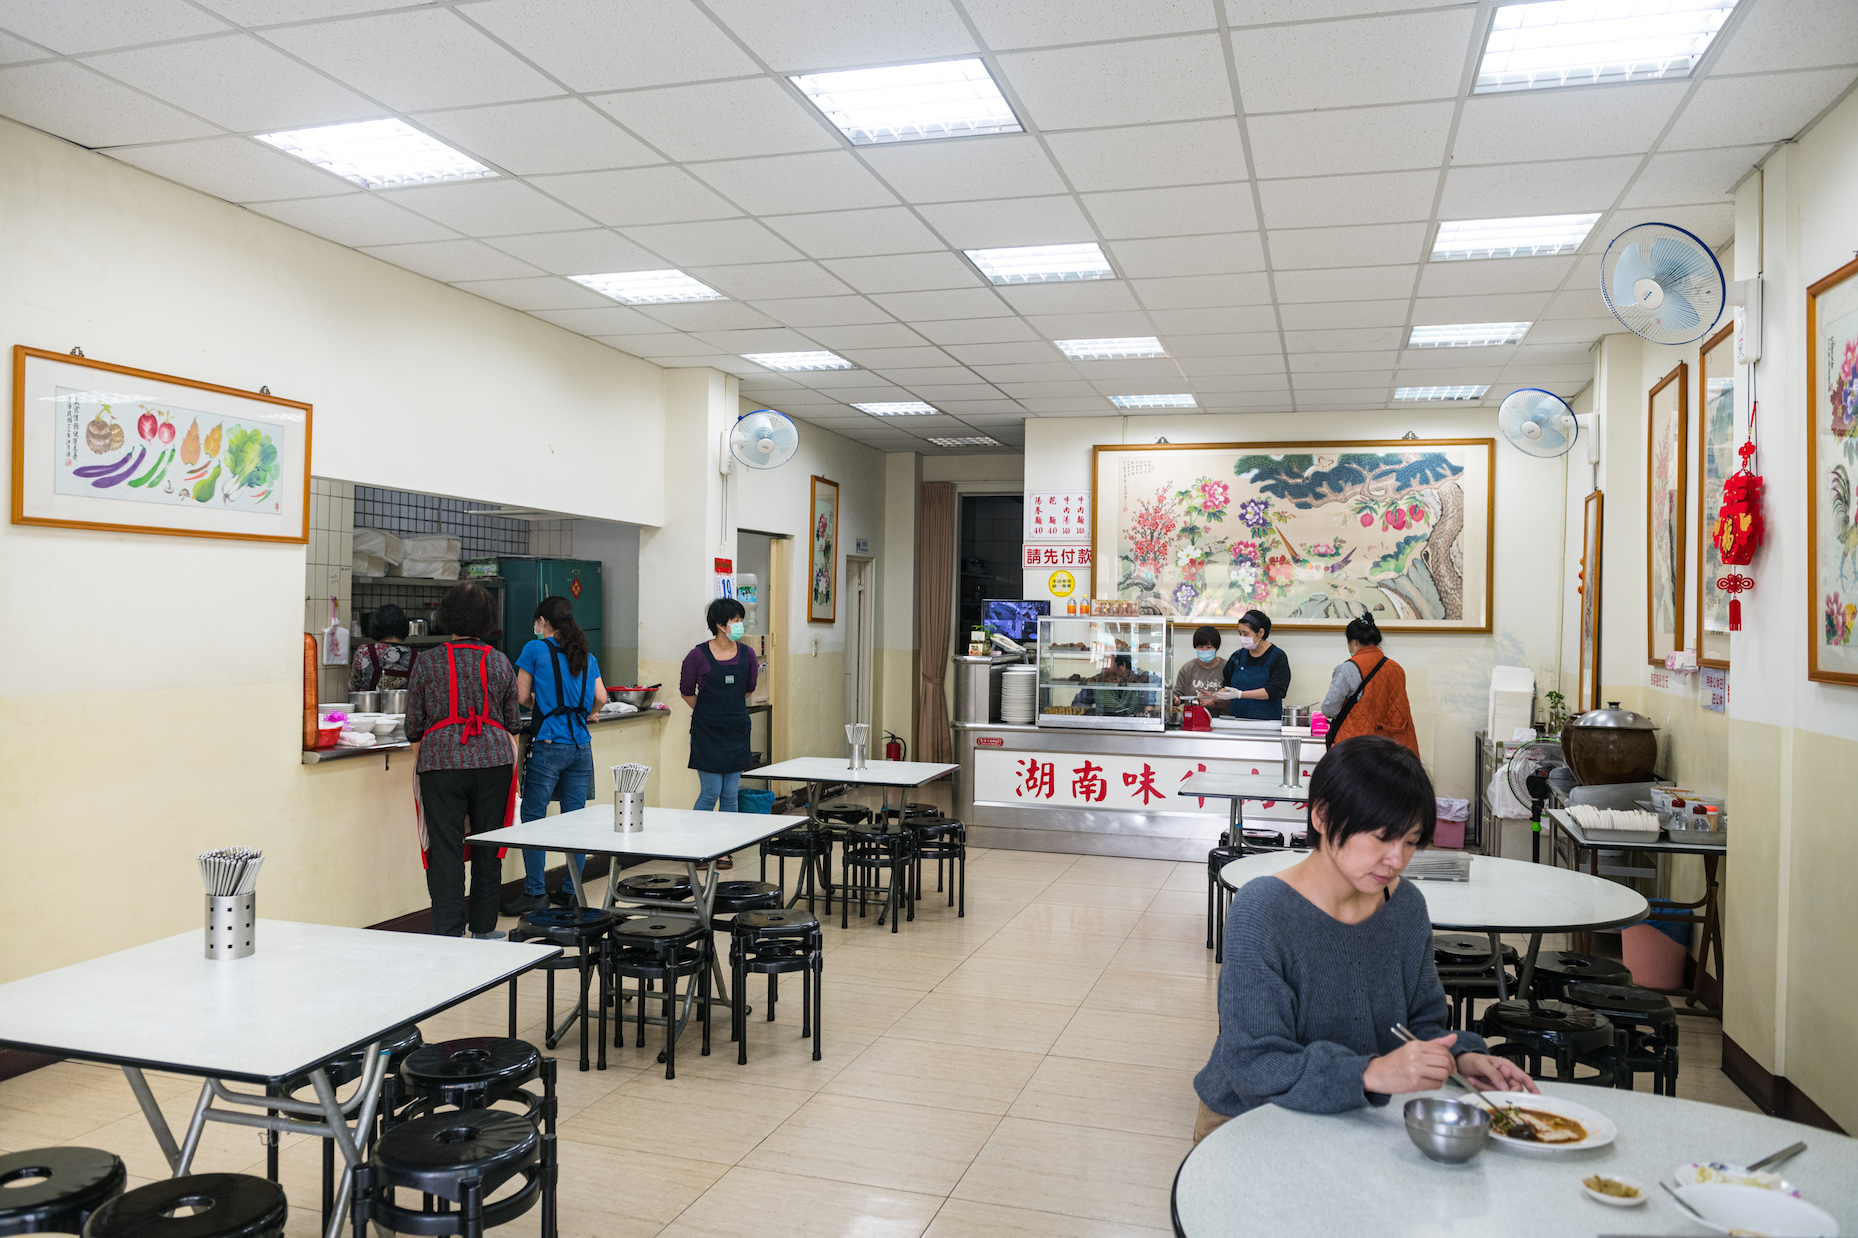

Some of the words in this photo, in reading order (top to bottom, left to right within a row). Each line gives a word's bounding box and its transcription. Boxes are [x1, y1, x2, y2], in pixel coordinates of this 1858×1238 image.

[1076, 496, 1085, 525] 牛肉麵
[1026, 548, 1091, 565] 請先付款
